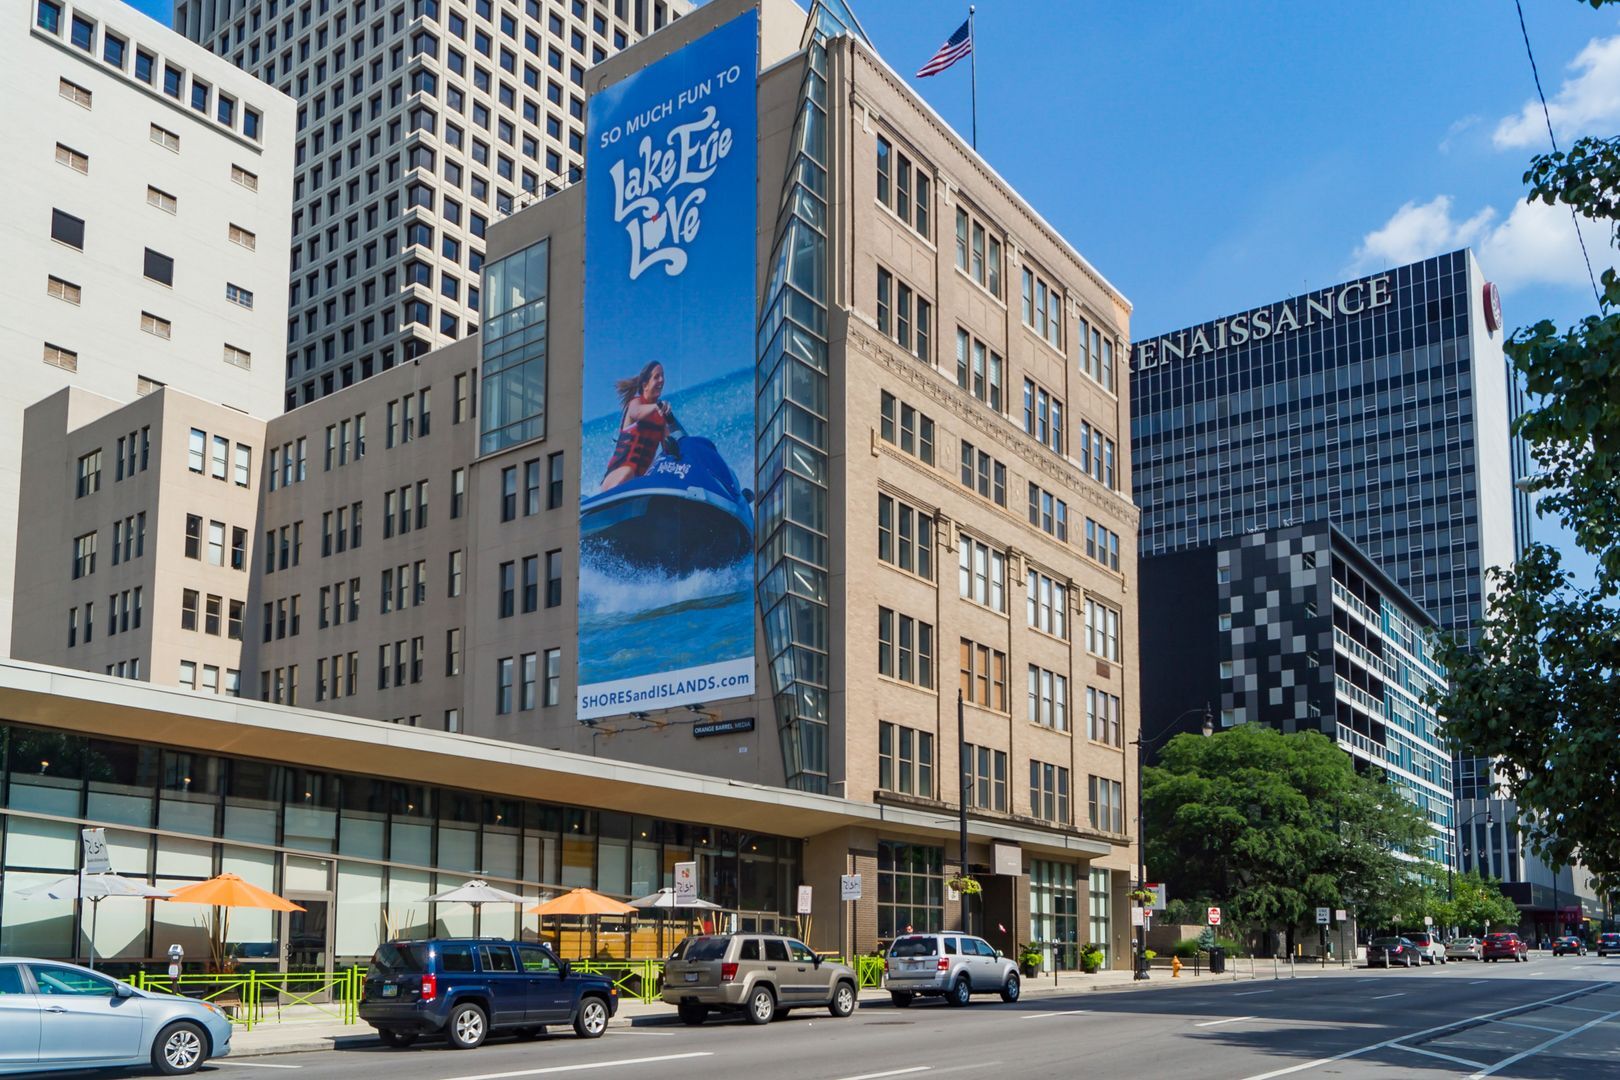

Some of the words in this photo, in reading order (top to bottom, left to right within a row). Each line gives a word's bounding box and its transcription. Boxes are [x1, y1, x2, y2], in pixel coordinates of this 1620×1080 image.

[600, 126, 621, 148] SO
[626, 100, 673, 136] MUCH
[678, 80, 711, 110] FUN
[716, 65, 740, 89] TO
[609, 136, 677, 222] Lake
[665, 105, 733, 195] Erie
[1130, 275, 1392, 373] ENAISSANCE
[582, 674, 749, 709] SHORESandISLANDS.com
[694, 726, 715, 734] ORANGE
[715, 723, 733, 731] BARREL
[734, 721, 751, 729] MEDIA
